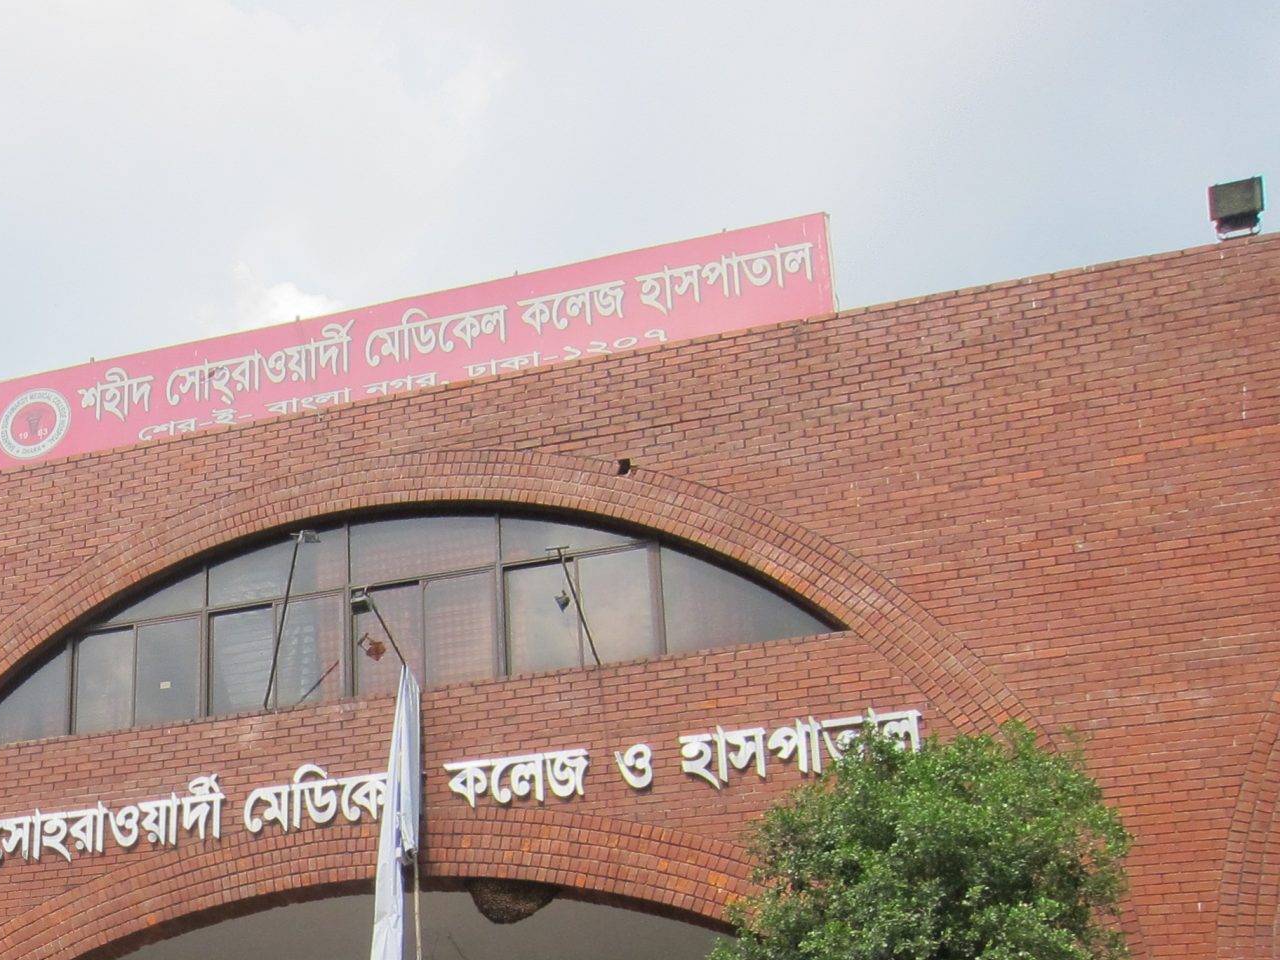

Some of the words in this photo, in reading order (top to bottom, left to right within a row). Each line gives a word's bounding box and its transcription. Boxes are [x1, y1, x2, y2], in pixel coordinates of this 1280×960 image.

[78, 366, 155, 421] শহীদ
[365, 304, 509, 368] মেডিকেল
[517, 280, 625, 335] কলেজ
[634, 242, 815, 316] হাসপাতাল
[264, 387, 352, 415] বাংলা
[243, 763, 389, 835] মেডিকে
[443, 748, 589, 808] কলেজ
[614, 743, 653, 790] ও
